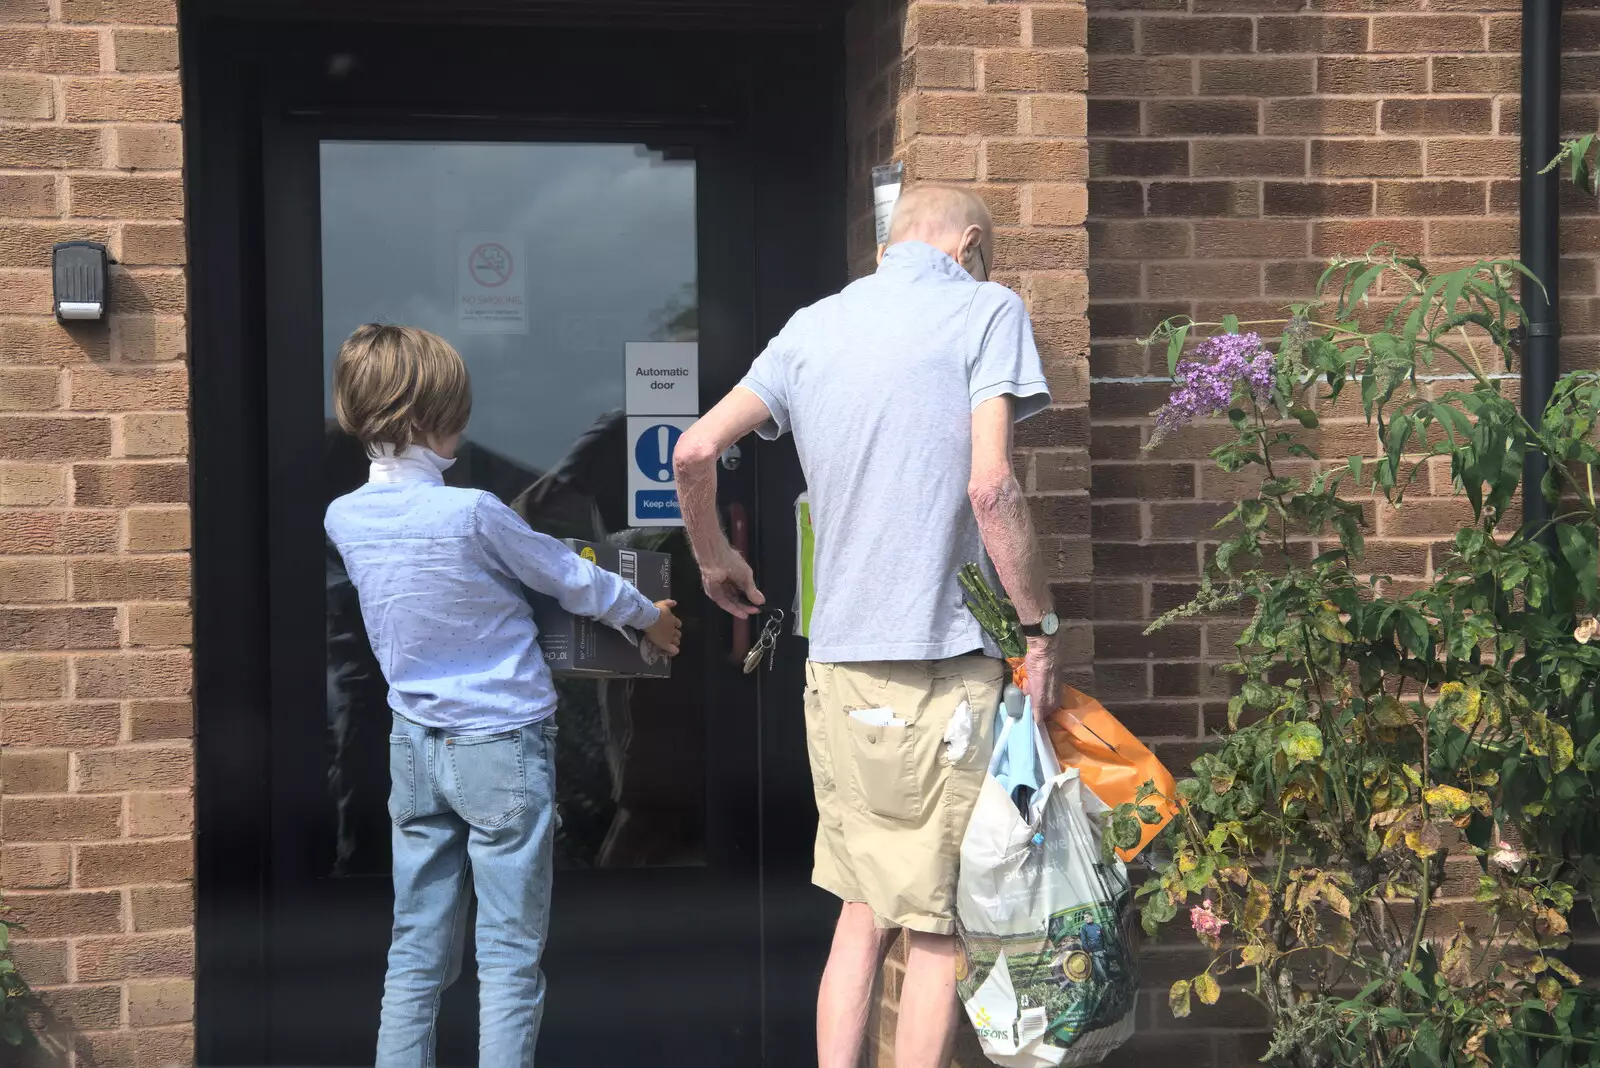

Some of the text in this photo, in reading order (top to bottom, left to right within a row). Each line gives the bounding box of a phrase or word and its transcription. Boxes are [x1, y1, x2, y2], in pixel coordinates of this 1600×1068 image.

[462, 294, 476, 305] NO
[635, 367, 689, 377] Automatic
[650, 380, 675, 390] door
[643, 500, 664, 509] Keep
